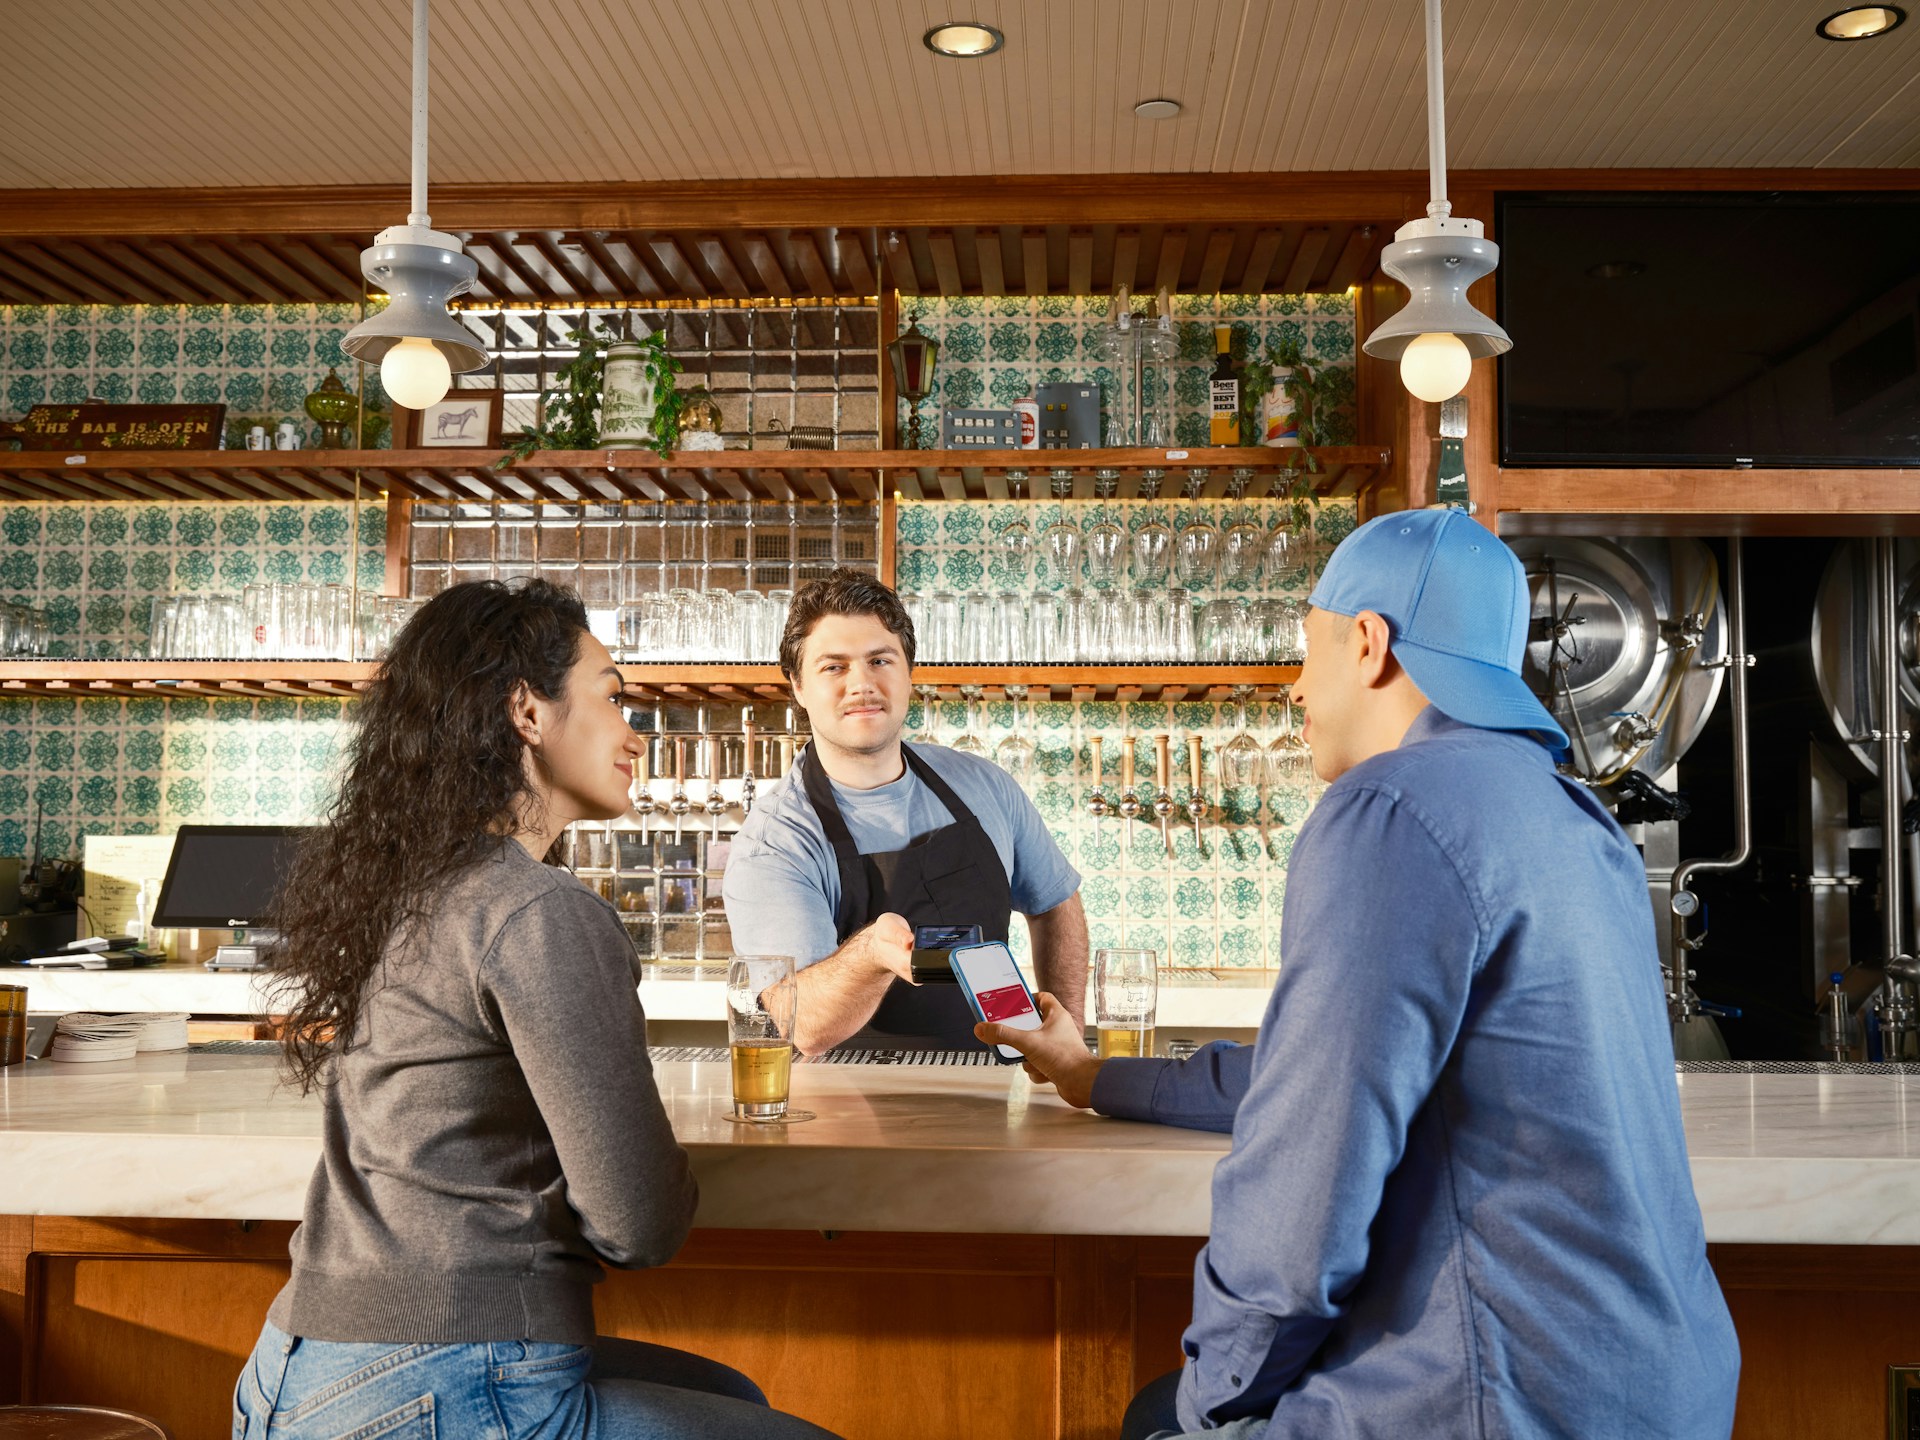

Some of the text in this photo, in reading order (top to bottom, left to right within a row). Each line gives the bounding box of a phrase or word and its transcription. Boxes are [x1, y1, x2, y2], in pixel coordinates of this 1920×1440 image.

[1213, 380, 1235, 388] Beer
[35, 421, 209, 434] THE BAR IS OPEN
